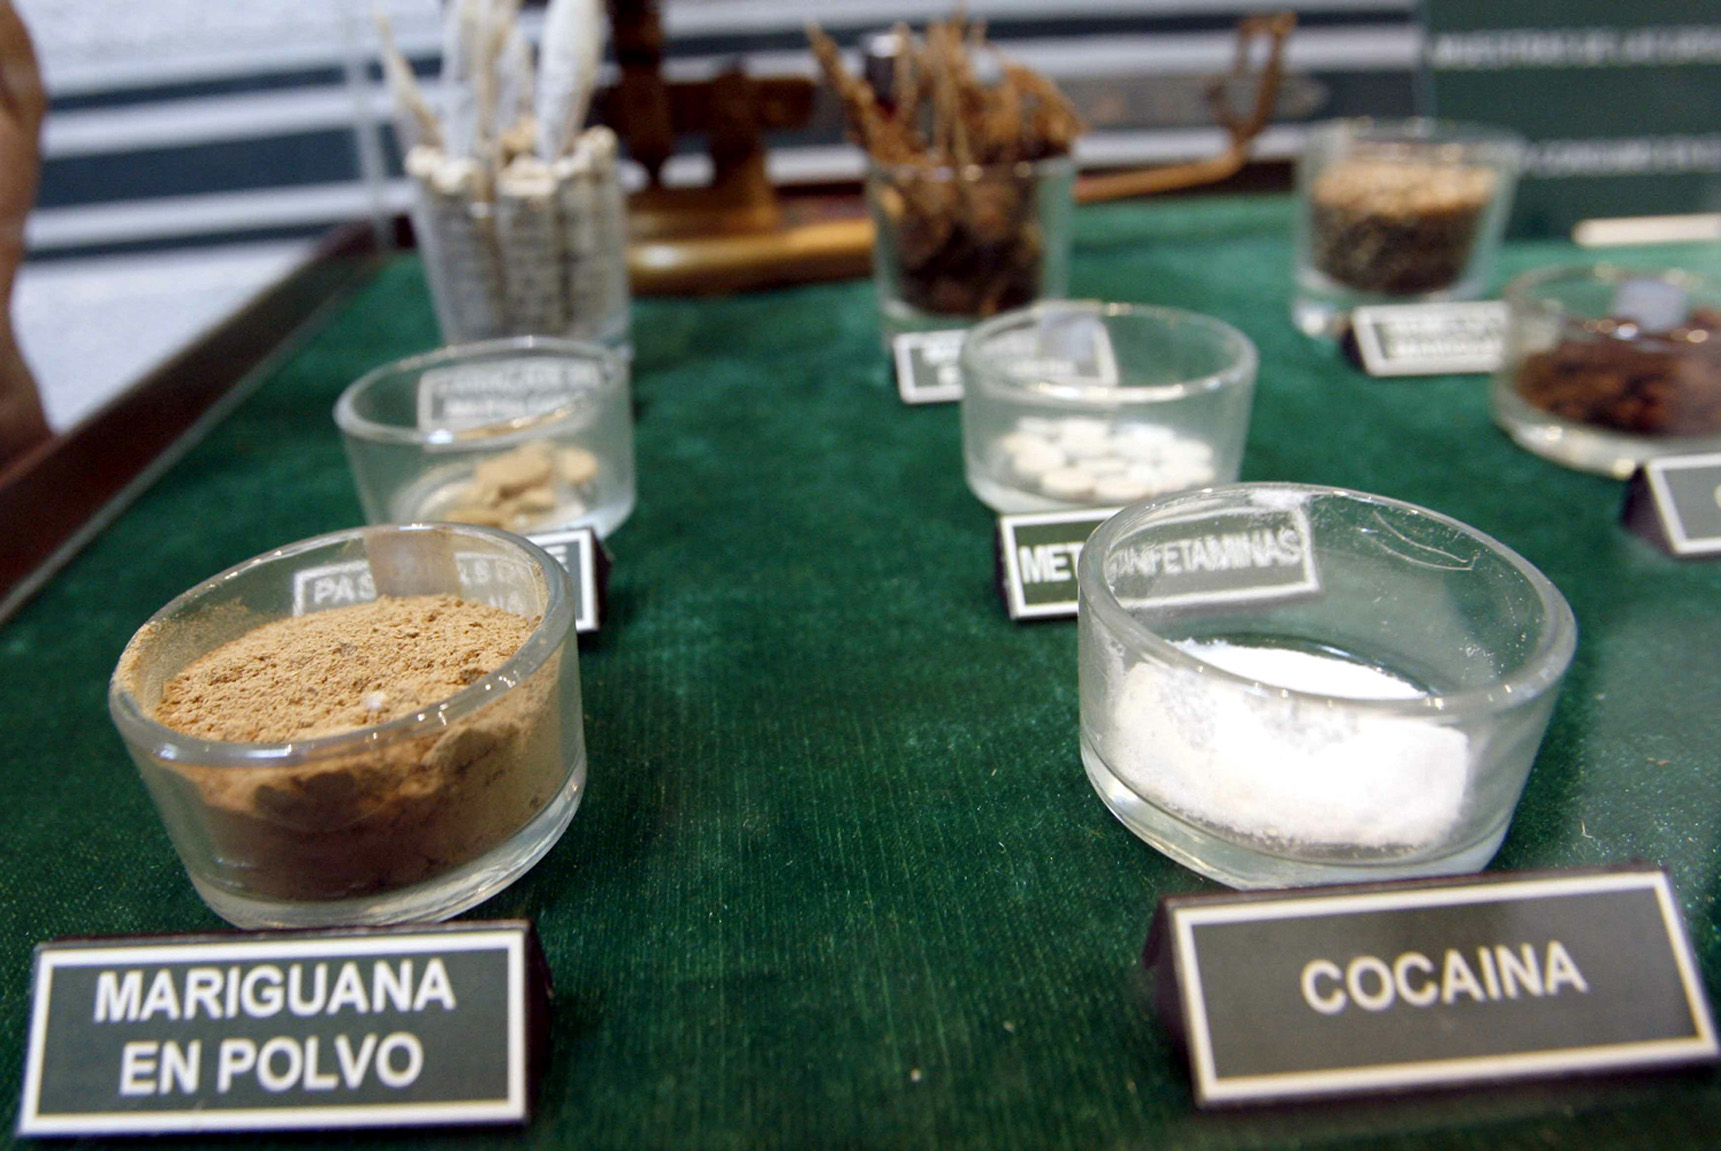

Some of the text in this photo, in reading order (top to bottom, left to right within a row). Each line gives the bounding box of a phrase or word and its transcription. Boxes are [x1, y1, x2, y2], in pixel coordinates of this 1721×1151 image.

[94, 958, 456, 1023] MARIGUANA
[1302, 941, 1588, 1015] COCAINA
[119, 1032, 424, 1096] EN POLVO
